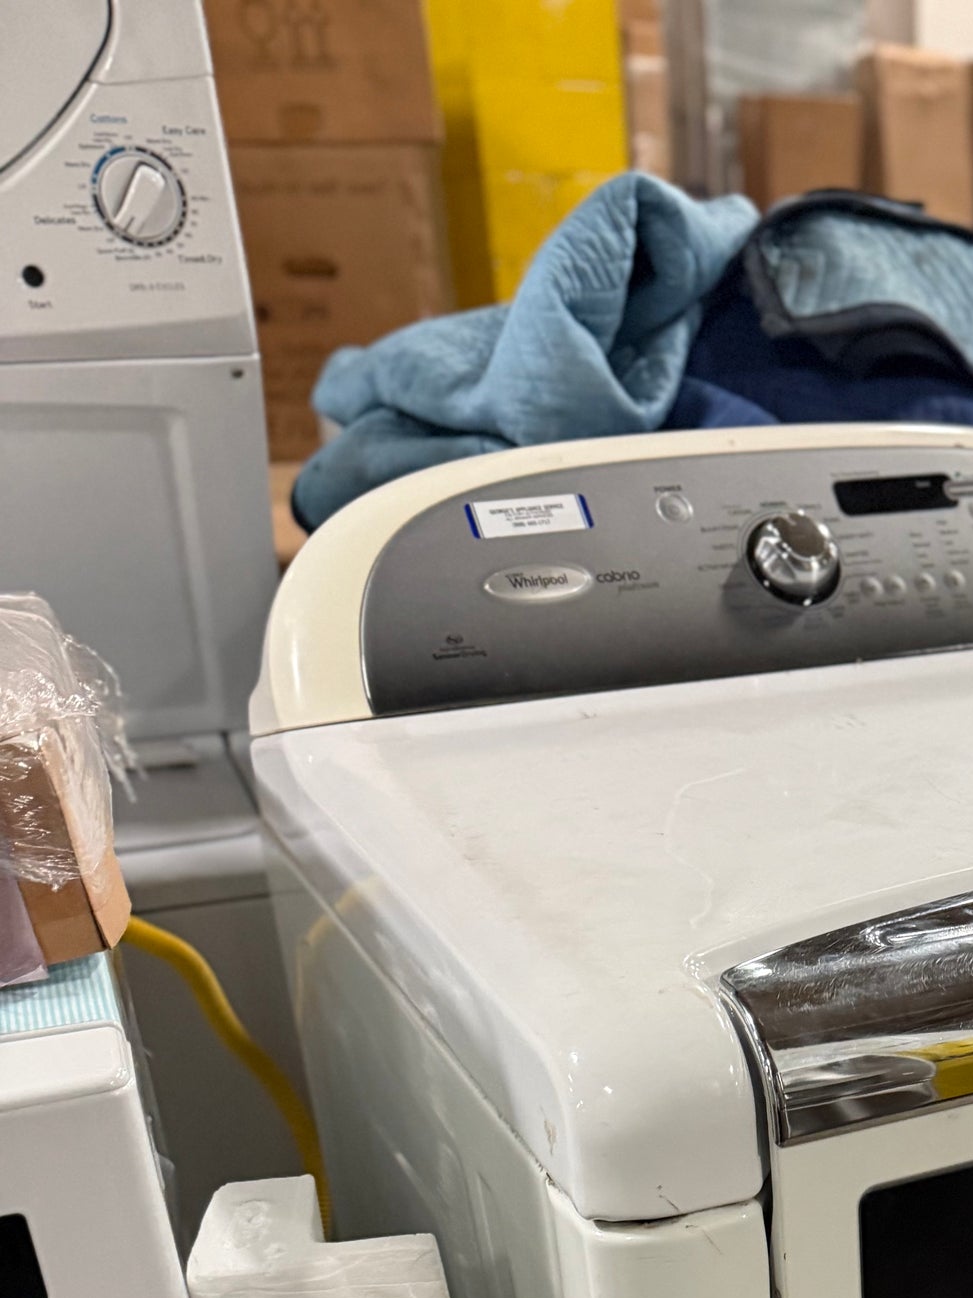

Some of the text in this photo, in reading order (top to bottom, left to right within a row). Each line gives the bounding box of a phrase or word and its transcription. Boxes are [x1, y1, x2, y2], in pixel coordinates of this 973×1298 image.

[162, 126, 206, 136] Easy Care
[506, 573, 569, 589] Whirlpool
